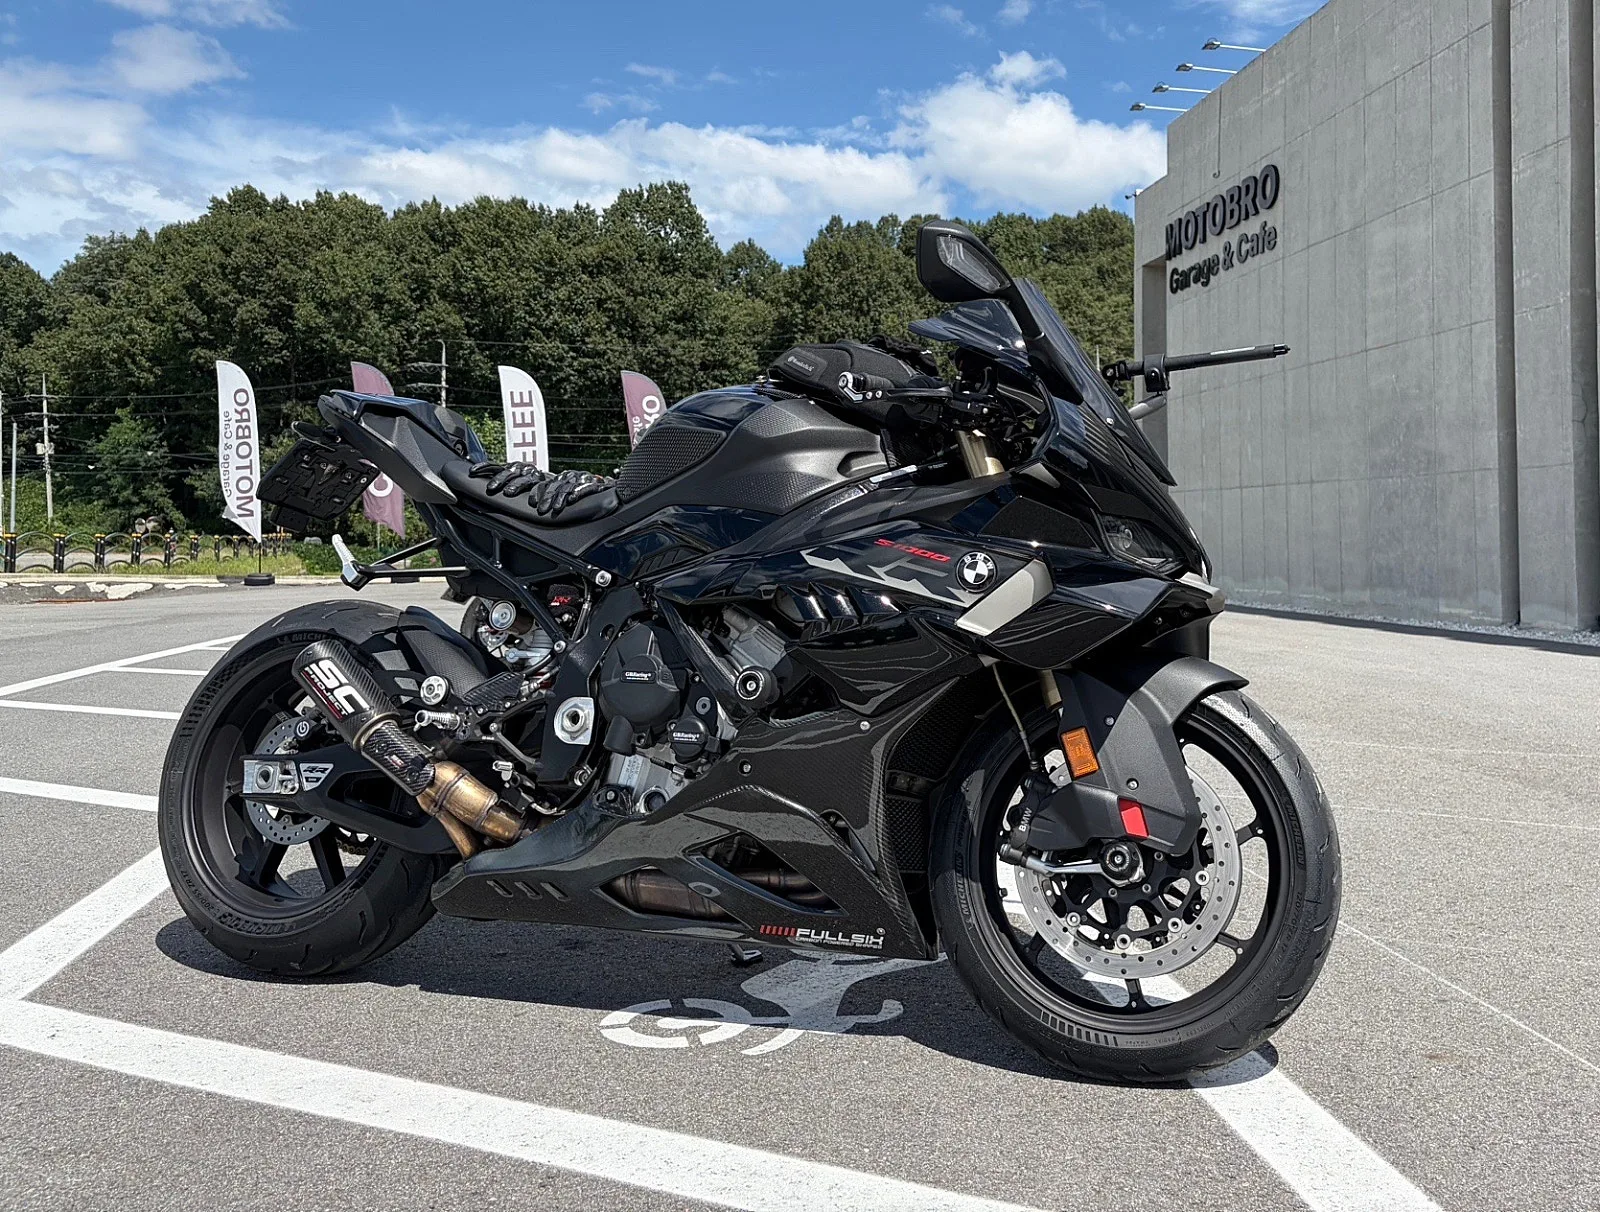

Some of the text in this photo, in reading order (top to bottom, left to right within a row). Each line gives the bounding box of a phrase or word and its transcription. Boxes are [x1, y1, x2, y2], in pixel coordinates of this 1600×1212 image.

[1165, 164, 1279, 260] MOTOBRO
[1169, 221, 1277, 294] Garage & Cafe
[963, 552, 995, 571] BMW
[304, 666, 349, 717] PROJECT
[309, 659, 371, 714] SC
[1018, 807, 1033, 832] BMW
[796, 928, 885, 945] FULLSIX
